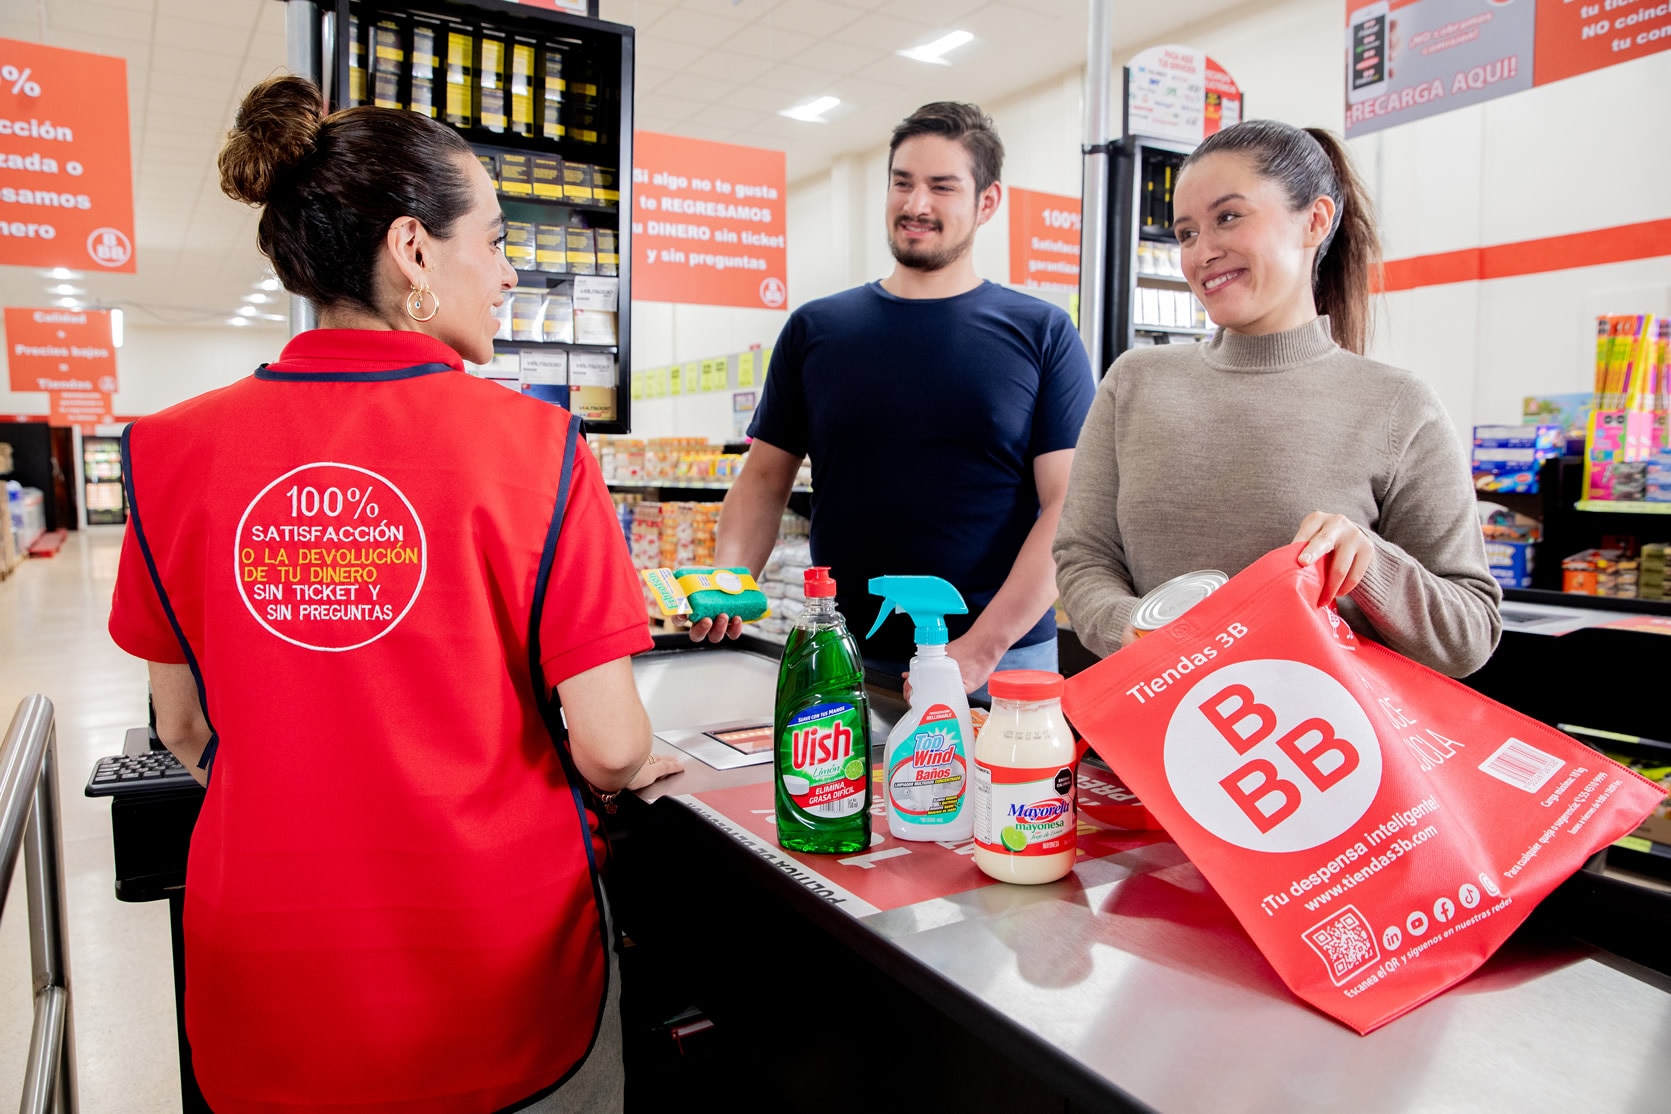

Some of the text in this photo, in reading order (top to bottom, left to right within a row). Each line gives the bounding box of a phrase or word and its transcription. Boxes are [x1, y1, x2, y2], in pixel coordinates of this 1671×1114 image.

[1580, 4, 1599, 19] tu
[1581, 20, 1610, 40] NO
[1611, 37, 1631, 52] tu
[1346, 80, 1445, 128] ¡RECARGA
[65, 161, 84, 176] o
[633, 168, 778, 199] Si algo no te gusta
[0, 187, 91, 210] samos
[639, 195, 772, 223] te REGRESAMOS
[647, 221, 711, 241] DINERO
[714, 229, 738, 243] sin
[741, 231, 785, 248] ticket
[647, 249, 767, 270] y sin preguntas
[286, 485, 379, 519] 100%
[252, 520, 403, 542] SATISFACCIÓN
[242, 542, 418, 564] O LA DEVOLUCIÓN
[244, 567, 377, 582] DE TU DINERO
[253, 584, 381, 600] SIN TICKET Y
[267, 604, 393, 620] SIN PREGUNTAS
[1126, 622, 1248, 704] Tiendas 3B
[1198, 684, 1277, 756] B
[792, 720, 853, 771] Vish
[915, 732, 944, 752] Top
[913, 744, 956, 768] Wind
[812, 764, 841, 778] Limón
[916, 767, 951, 781] Baños
[809, 786, 855, 805] GRASA DIFÍCIL
[815, 781, 845, 795] ELIMINA
[1007, 799, 1070, 821] Mayorela
[1015, 820, 1064, 833] mayonesa
[1260, 795, 1440, 917] ¡Tu despensa inteligente!
[1504, 865, 1522, 878] Para
[1517, 843, 1542, 867] cualquier
[1304, 825, 1438, 911] www.tiendas3b.com
[1344, 971, 1378, 998] Escanea
[1377, 966, 1387, 978] el
[1385, 957, 1400, 972] QR
[1401, 955, 1407, 965] y
[1444, 928, 1454, 938] en
[1455, 911, 1491, 932] nuestras
[1492, 896, 1513, 914] redes
